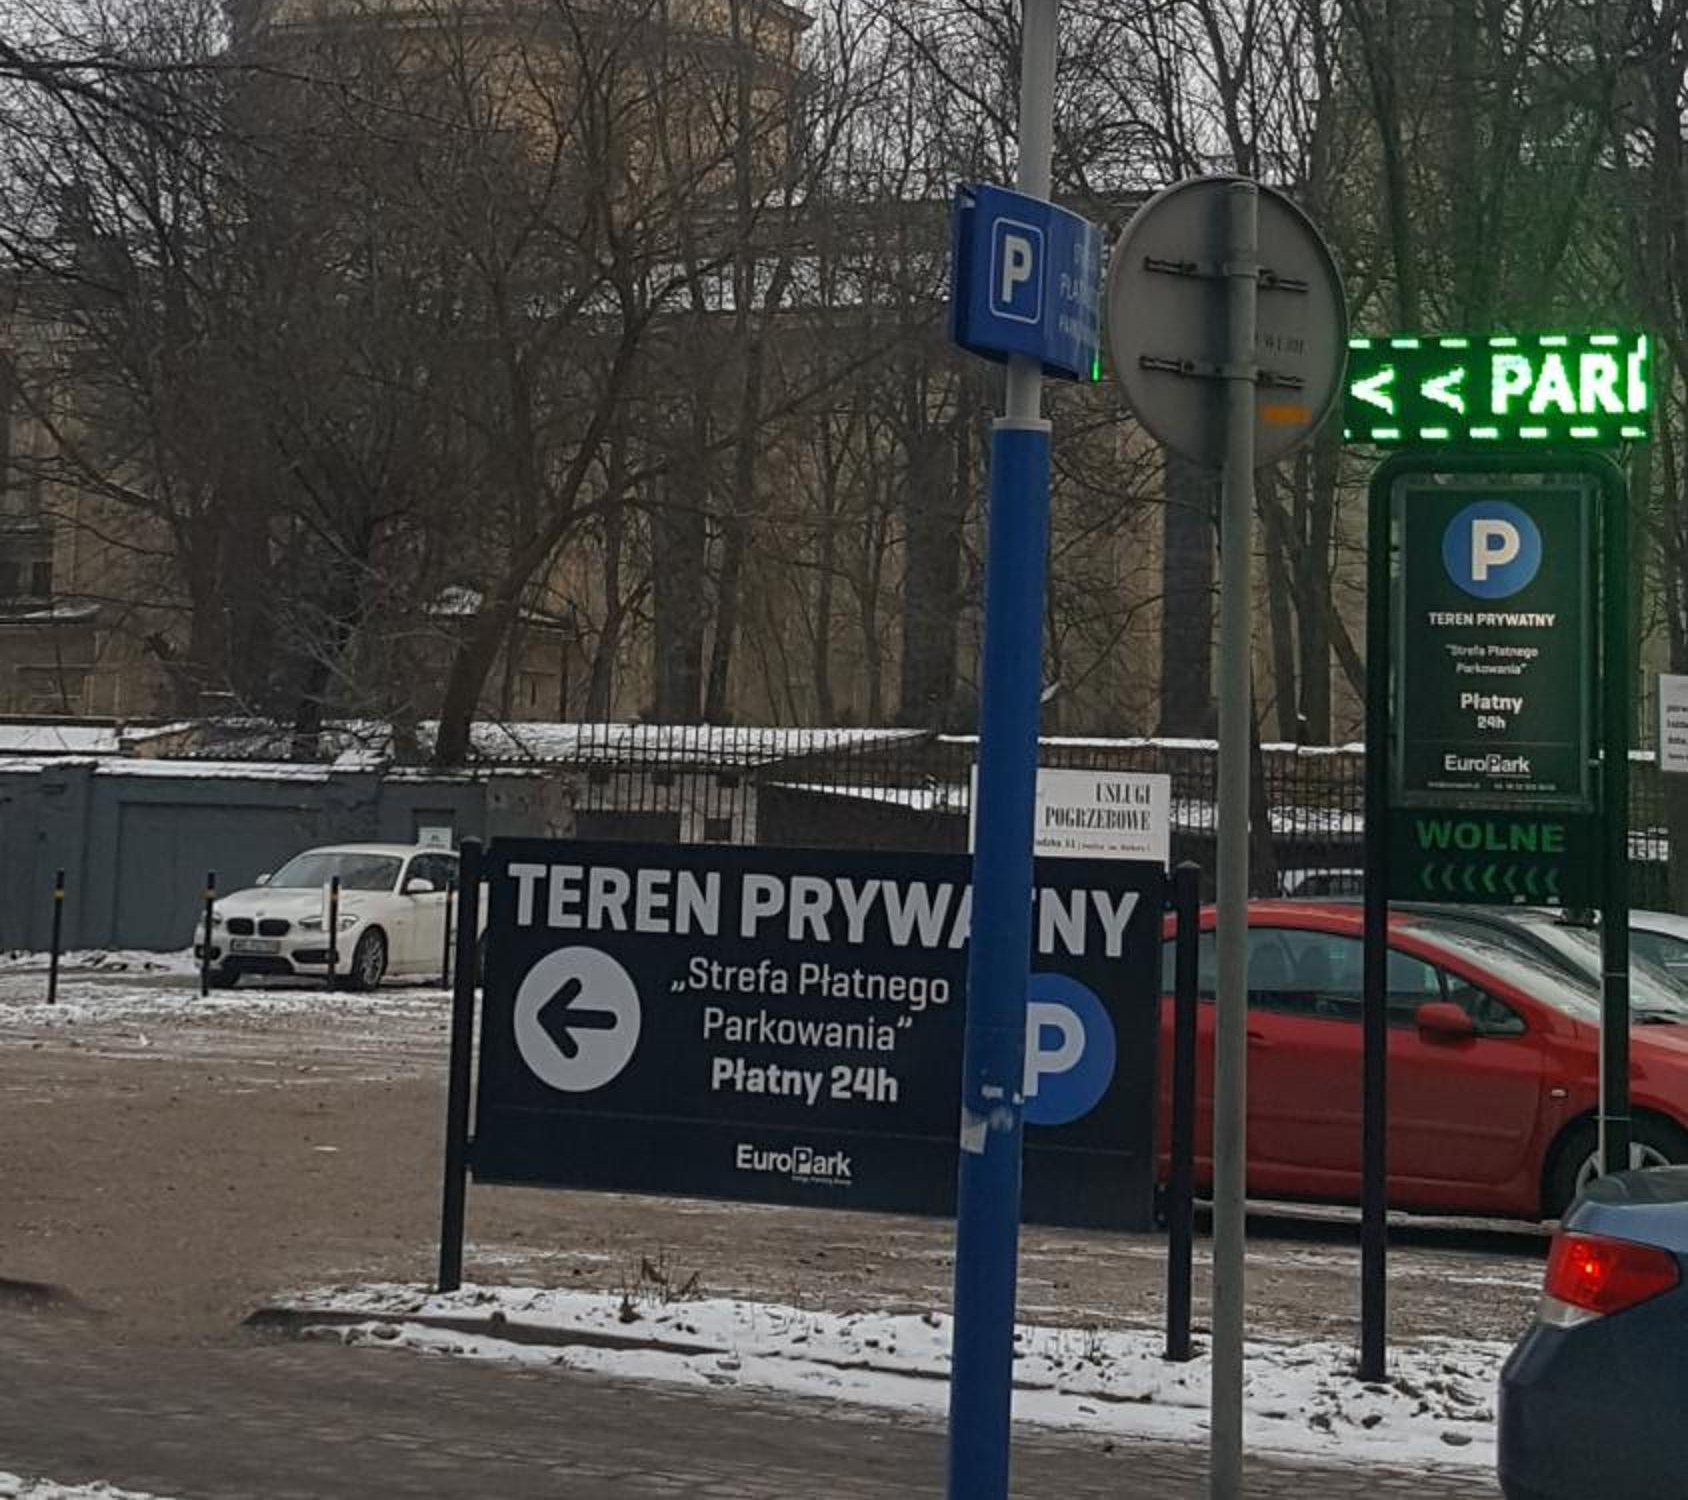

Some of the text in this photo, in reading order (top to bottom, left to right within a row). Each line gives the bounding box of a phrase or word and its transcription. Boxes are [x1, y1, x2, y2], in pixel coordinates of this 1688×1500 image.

[1001, 234, 1033, 303] P
[1471, 518, 1521, 582] P
[1428, 611, 1556, 629] TEREN PRYWATNY
[1460, 692, 1523, 715] Płatny
[1476, 714, 1507, 730] 24h
[1444, 753, 1531, 774] EuroPark
[1045, 806, 1151, 831] POGRZEBOWE
[1416, 819, 1564, 853] WOLNE
[507, 861, 1141, 959] TEREN PRYWNY
[798, 962, 950, 1011] Płatnego
[711, 1056, 899, 1106] Płatny 24h
[736, 1143, 852, 1177] EuroPark
